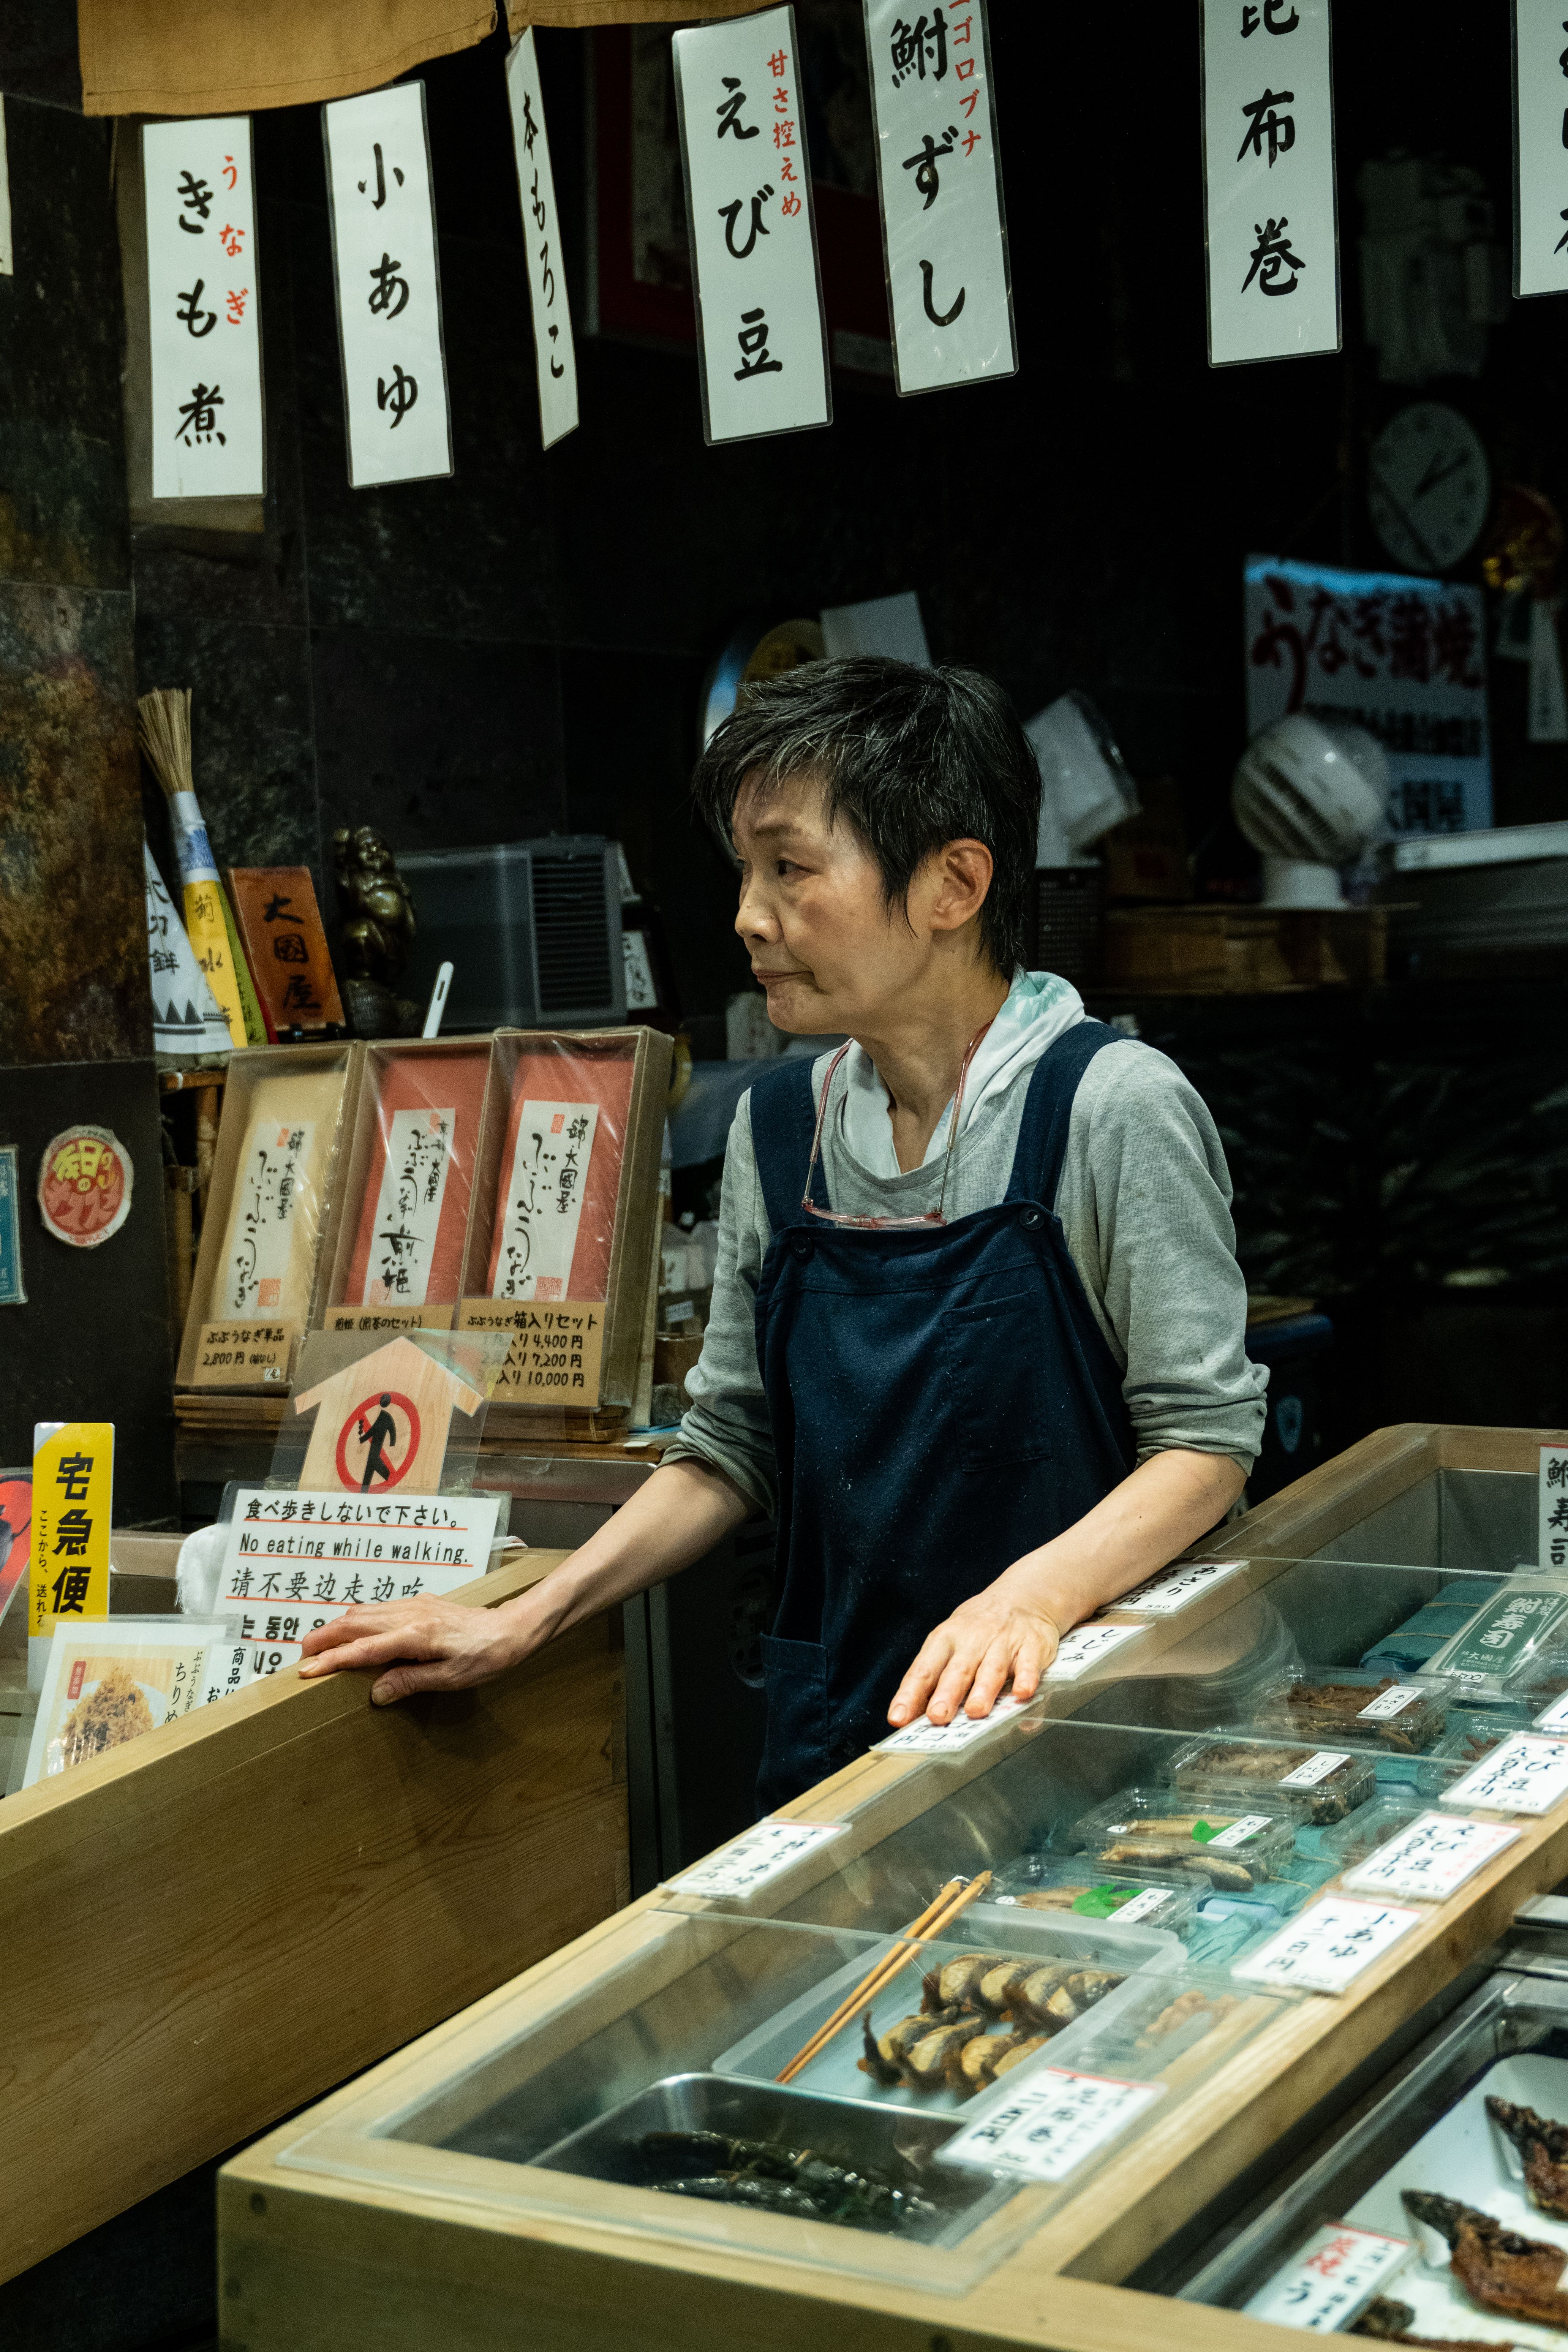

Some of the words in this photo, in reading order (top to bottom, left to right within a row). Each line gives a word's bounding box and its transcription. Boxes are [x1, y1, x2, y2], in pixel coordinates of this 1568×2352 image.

[767, 49, 802, 217] 甘さ控えめ
[890, 8, 966, 327] 鮒ずし
[219, 155, 248, 324] うなぎ
[716, 77, 783, 381] えび豆
[358, 142, 418, 428] 小あゆ
[175, 170, 226, 447] きも煮
[533, 1334, 583, 1349] 4,400円
[533, 1353, 582, 1368] 7,200円
[528, 1372, 584, 1388] 10,000円
[52, 1451, 94, 1614] 宅急便
[246, 1498, 457, 1528] 食べ歩きしないで下さい。
[241, 1533, 259, 1552] No
[267, 1536, 324, 1558] eating
[334, 1537, 382, 1558] while
[392, 1540, 468, 1565] walking.
[231, 1567, 424, 1604] 请不要边走边吃
[1165, 1566, 1218, 1597] あさり
[266, 1616, 299, 1641] 동안
[1061, 1629, 1121, 1662] しじみ
[184, 1651, 203, 1712] ぶぶうなぎ
[1329, 1912, 1394, 1957] 小あゆ
